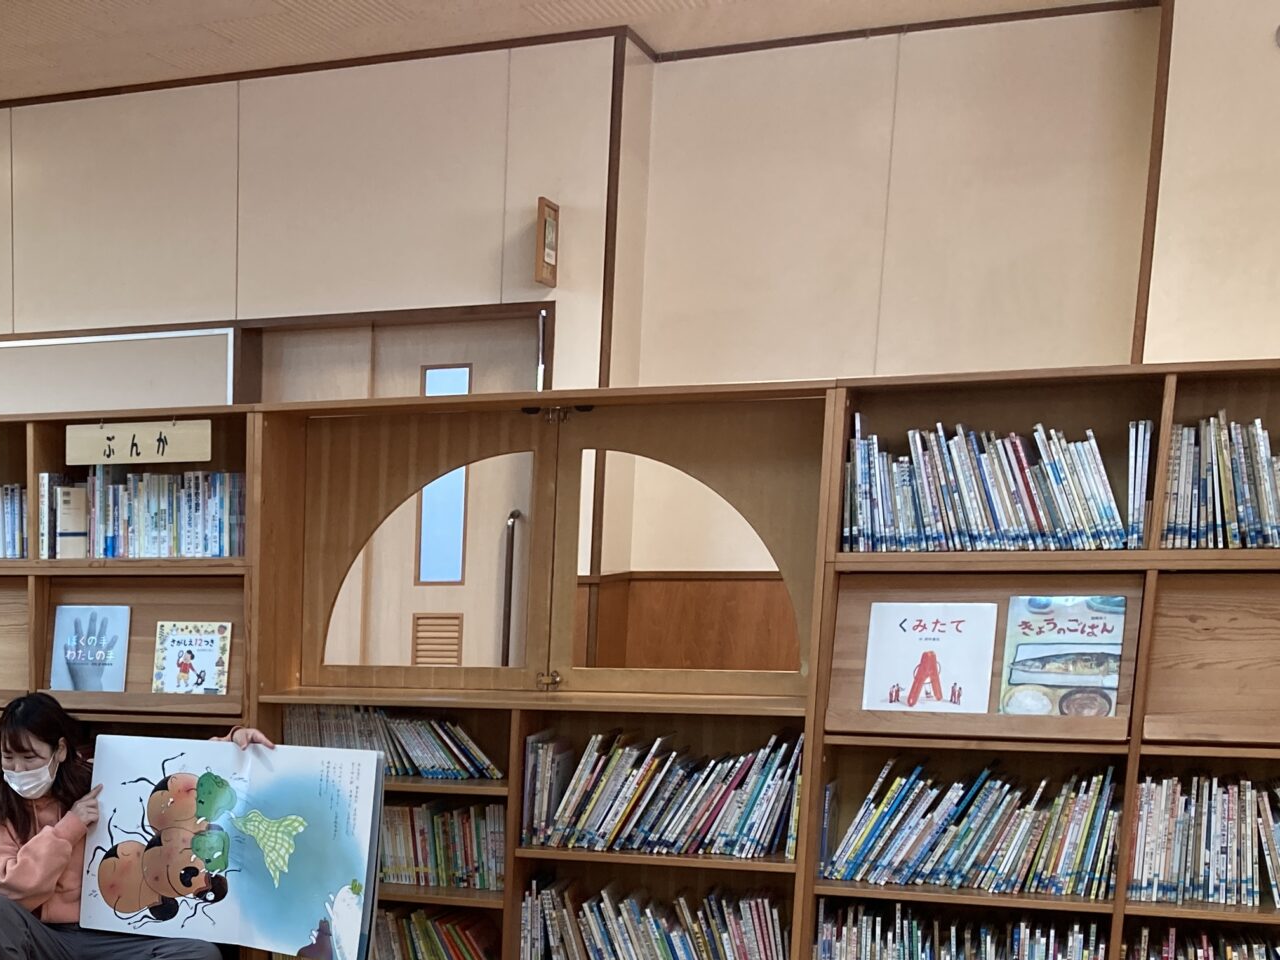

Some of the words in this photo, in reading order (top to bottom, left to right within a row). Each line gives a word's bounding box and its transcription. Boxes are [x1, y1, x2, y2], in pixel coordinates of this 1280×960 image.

[103, 431, 168, 458] ぶんか
[899, 618, 966, 633] くみたて
[1017, 618, 1115, 637] きょうのごはん
[65, 649, 116, 661] わたしの手
